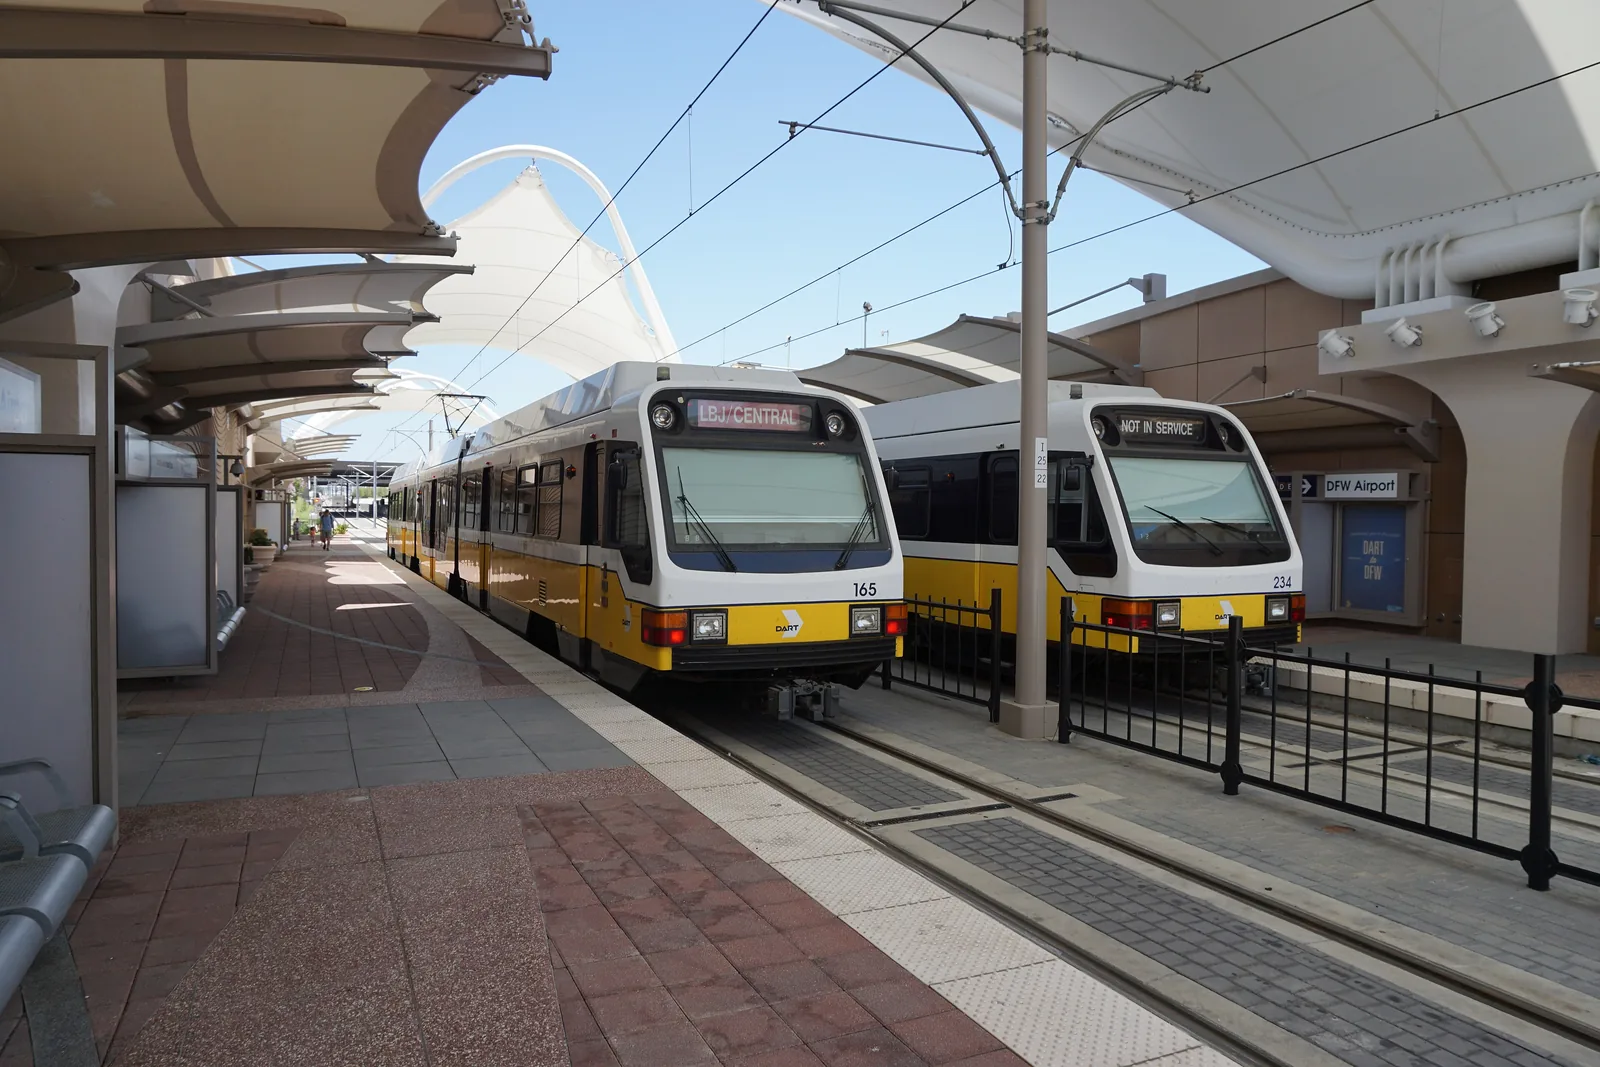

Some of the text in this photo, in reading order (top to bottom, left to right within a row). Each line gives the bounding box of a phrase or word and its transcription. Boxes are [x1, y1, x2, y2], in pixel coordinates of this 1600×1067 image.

[699, 404, 798, 426] LBJ/CENTRAL
[1121, 419, 1193, 436] NOT IN SERVICE
[1037, 455, 1047, 466] 25
[1037, 473, 1047, 484] 22
[1326, 479, 1395, 494] DFW Airport
[1363, 540, 1385, 555] DART
[1364, 565, 1383, 580] DFW
[853, 582, 877, 597] 165
[1273, 575, 1292, 589] 234
[775, 624, 799, 632] DART
